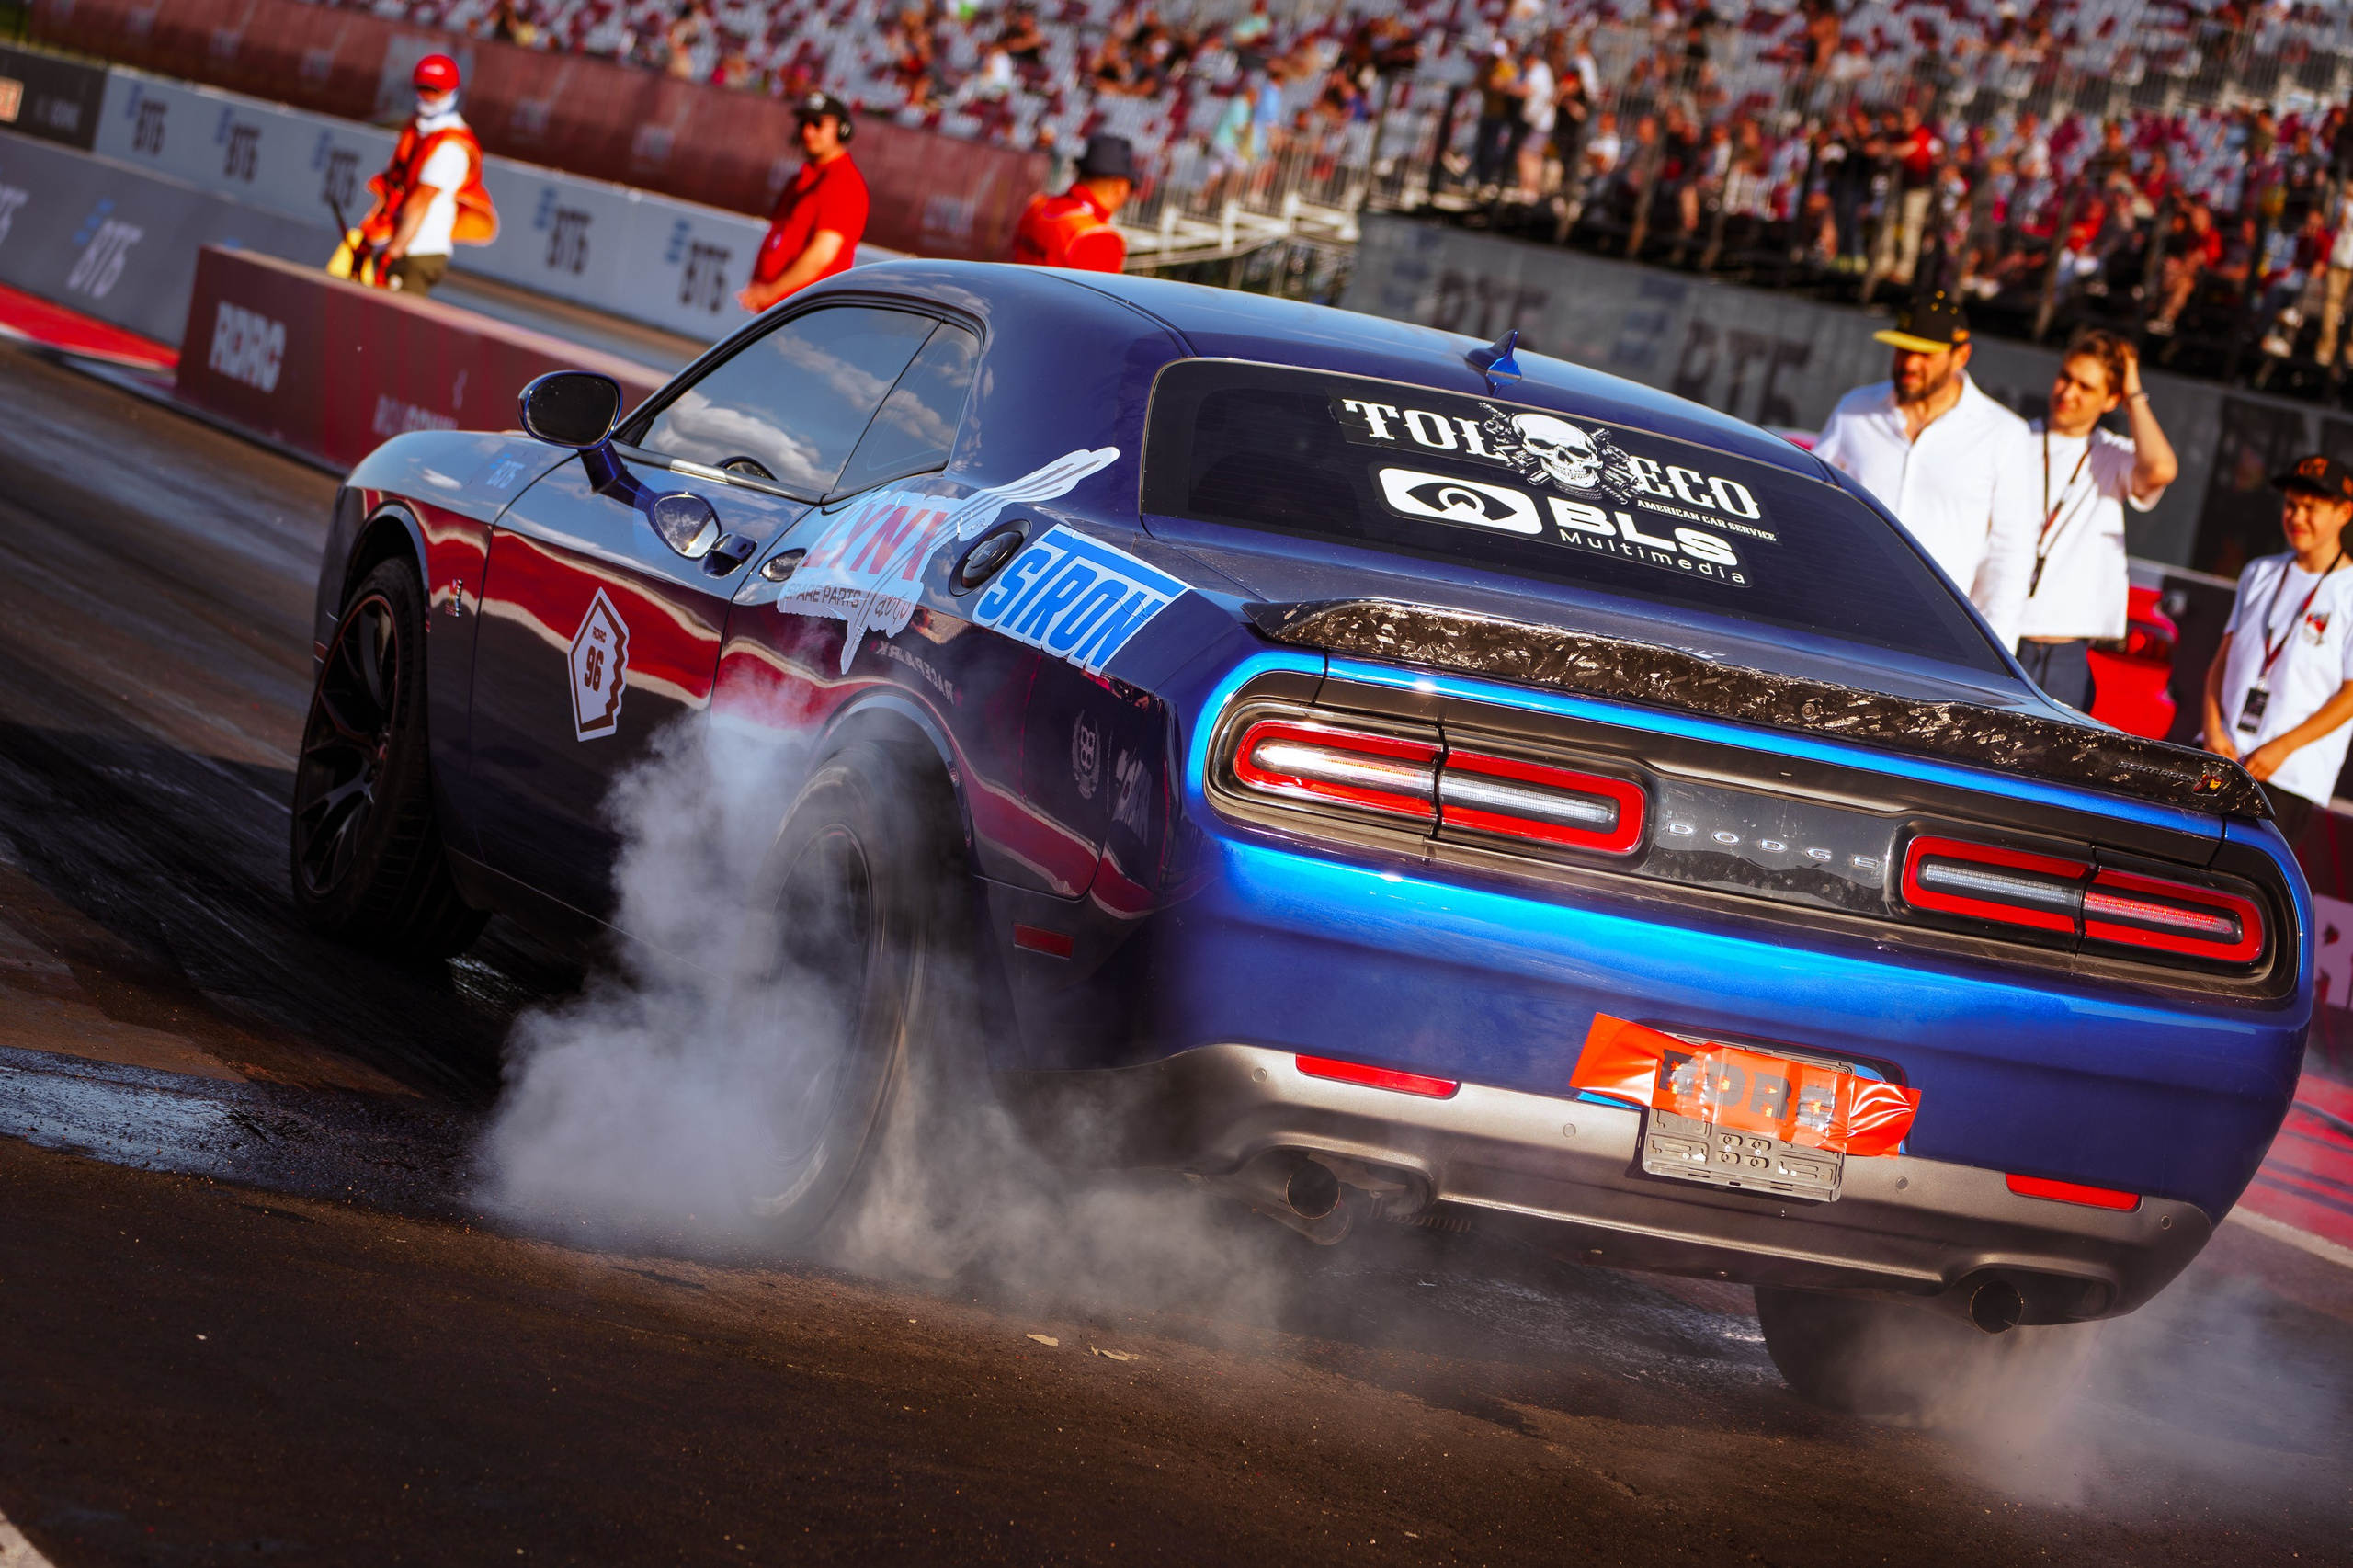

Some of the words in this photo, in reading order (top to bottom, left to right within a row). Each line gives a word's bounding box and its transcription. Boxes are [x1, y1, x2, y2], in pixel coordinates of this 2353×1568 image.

[1627, 455, 1762, 521] ECO
[1547, 496, 1738, 566] BLS
[1637, 499, 1701, 522] AMERICAN
[1702, 515, 1728, 529] CAR
[1727, 521, 1778, 542] SERVICE
[1559, 528, 1745, 585] Multimedia
[784, 582, 821, 603] SPARE
[821, 585, 862, 608] PARTS
[584, 645, 605, 693] 96
[1667, 823, 1879, 870] DODGE
